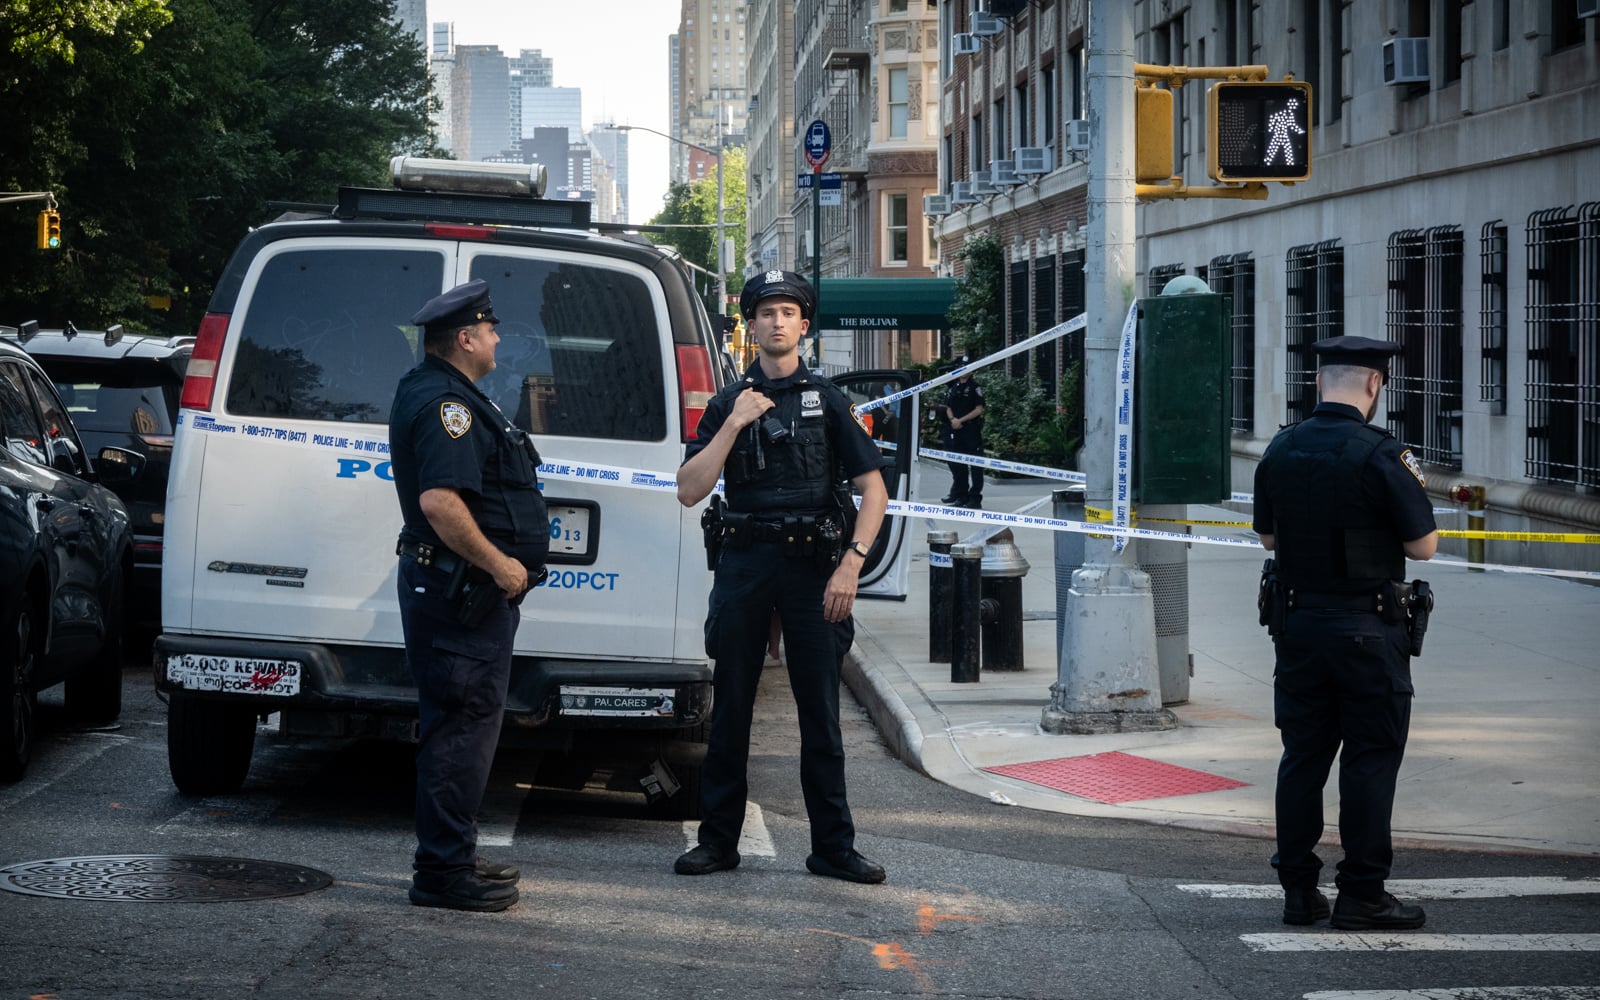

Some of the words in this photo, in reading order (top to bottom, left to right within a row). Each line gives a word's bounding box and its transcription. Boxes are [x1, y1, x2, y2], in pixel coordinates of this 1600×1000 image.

[840, 317, 858, 326] THE
[859, 317, 898, 326] BOLIVAR
[242, 424, 288, 441] 1-800-577-TIPS
[288, 429, 307, 443] (8477)
[312, 434, 335, 447] POLICE
[335, 437, 349, 448] LINE
[354, 440, 363, 450] DO
[364, 441, 377, 452] NOT
[377, 442, 391, 454] CRO
[1118, 434, 1127, 451] CROSS
[1118, 451, 1127, 461] NOT
[537, 463, 556, 473] OLICE
[556, 464, 570, 475] LINE
[576, 467, 585, 477] DO
[586, 468, 599, 478] NOT
[599, 469, 620, 481] CROSS
[1118, 461, 1127, 469] DO
[1118, 473, 1127, 484] LINE
[1118, 484, 1127, 501] POLICE
[908, 504, 955, 516] 1-800-577-TIPS
[955, 509, 976, 519] (8477)
[981, 512, 1003, 521] POLICE
[1024, 516, 1033, 524] DO
[1047, 519, 1068, 527] CROSS
[234, 660, 298, 677] REWARD
[594, 697, 613, 707] PAL
[614, 698, 648, 707] CARES
